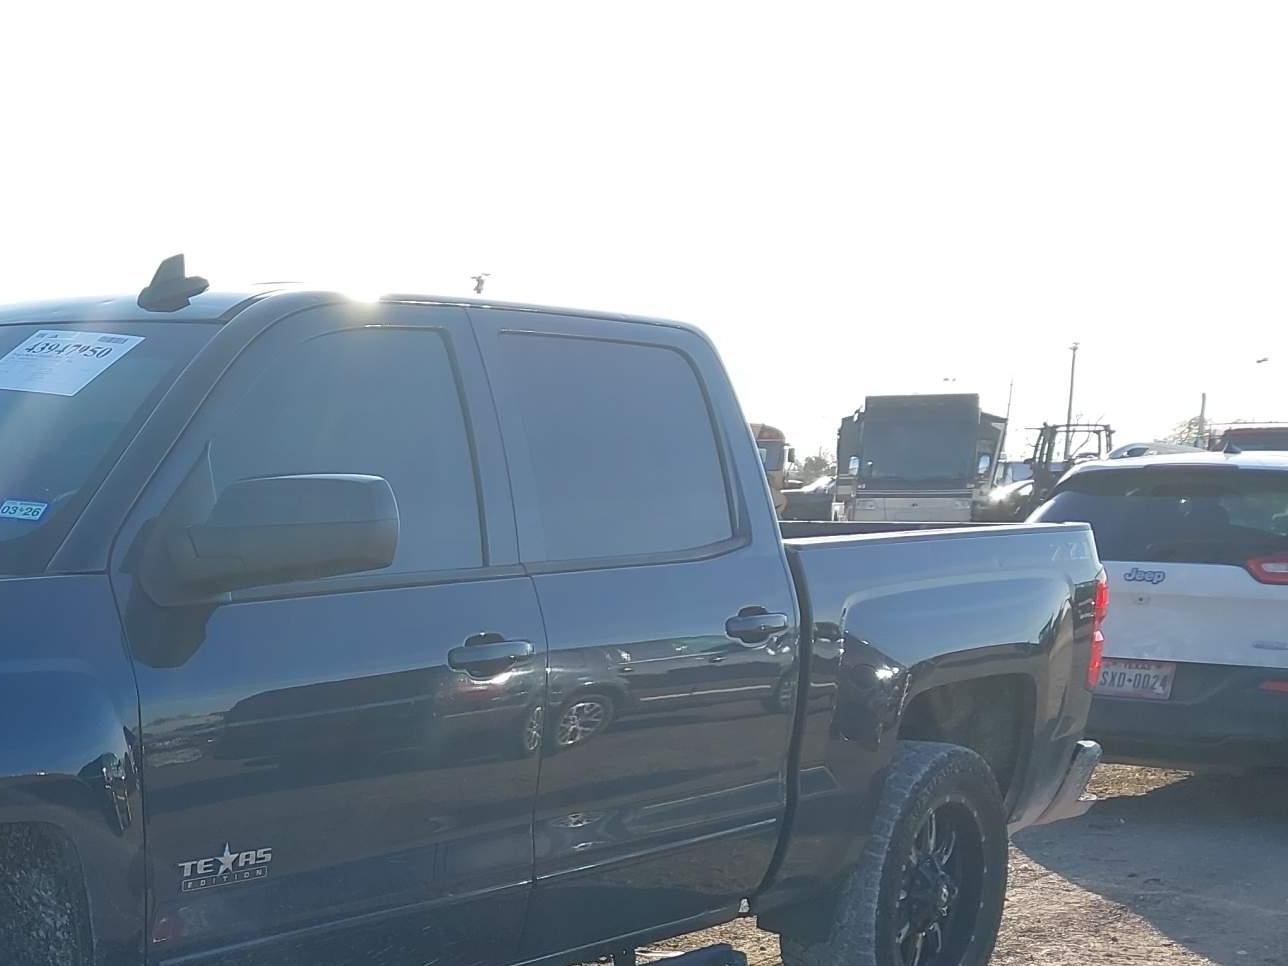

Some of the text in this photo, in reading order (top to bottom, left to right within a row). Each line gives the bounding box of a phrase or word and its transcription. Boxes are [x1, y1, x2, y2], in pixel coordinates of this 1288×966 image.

[1123, 567, 1166, 584] Jeep
[178, 842, 272, 877] TEXAS
[187, 869, 263, 889] EDITION
